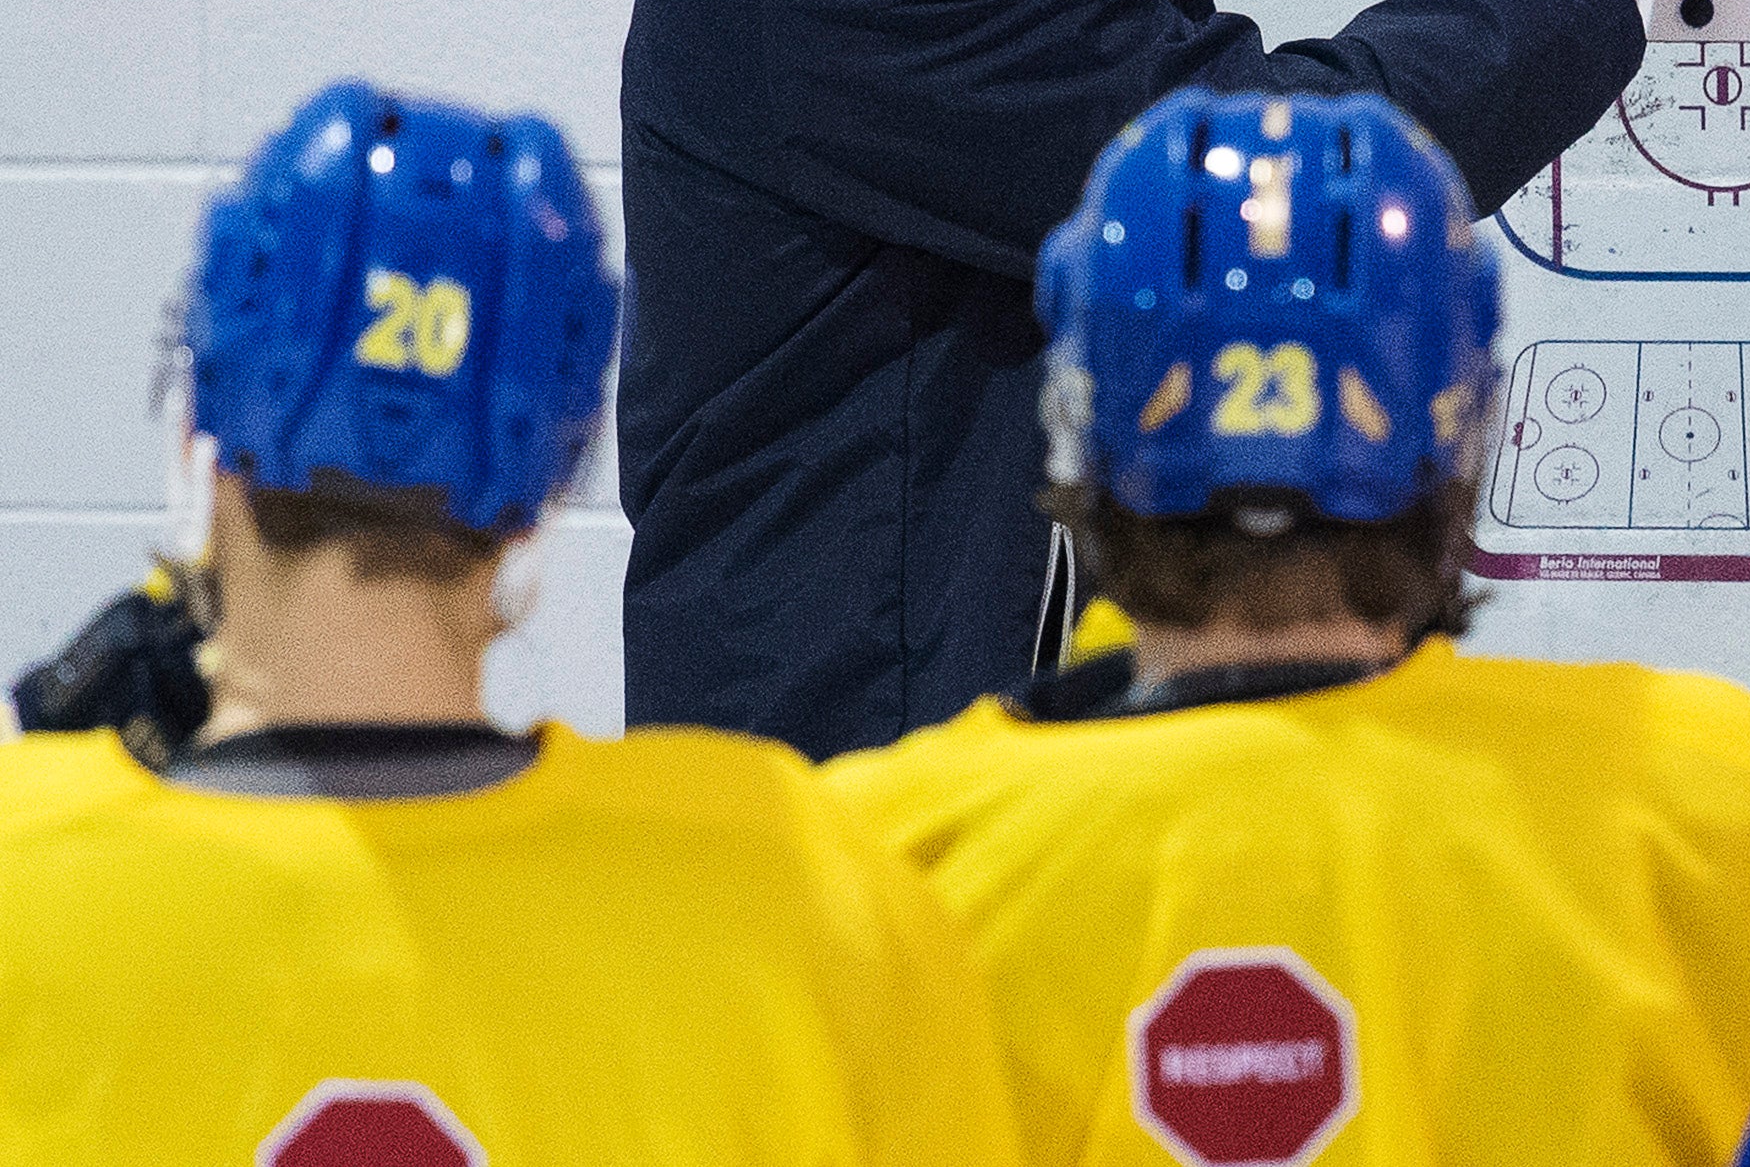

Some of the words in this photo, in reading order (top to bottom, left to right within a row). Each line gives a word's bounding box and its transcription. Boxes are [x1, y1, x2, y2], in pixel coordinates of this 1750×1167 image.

[356, 268, 471, 377] 20
[1211, 341, 1321, 436] 23
[1577, 555, 1661, 570] International
